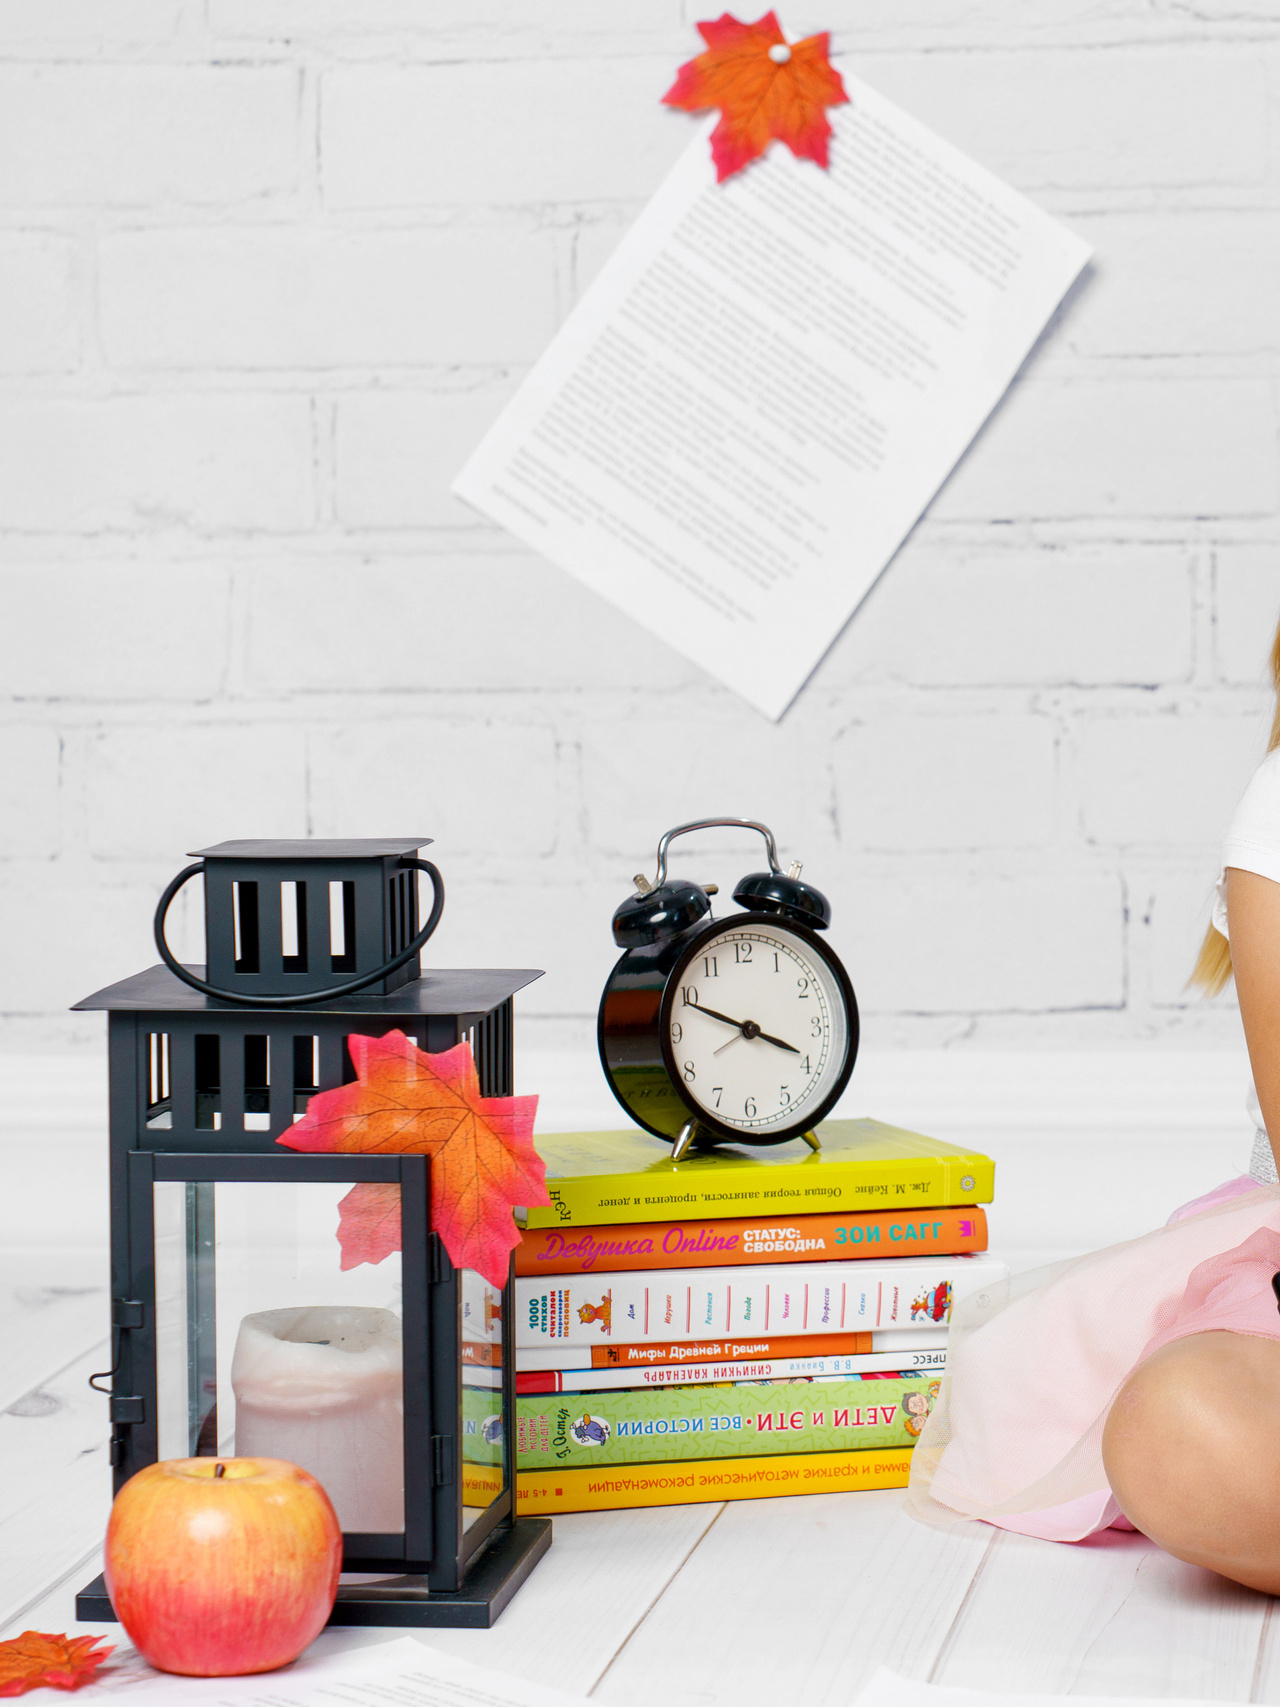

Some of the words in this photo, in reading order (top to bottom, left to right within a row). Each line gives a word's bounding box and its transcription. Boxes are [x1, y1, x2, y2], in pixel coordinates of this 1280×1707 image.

[734, 943, 753, 963] 12
[703, 957, 719, 978] 11
[774, 953, 780, 973] 1
[680, 986, 698, 1006] 10
[798, 978, 809, 999] 2
[671, 1023, 682, 1043] 9
[811, 1017, 822, 1038] 3
[684, 1061, 696, 1081] 8
[800, 1054, 813, 1074] 4
[712, 1087, 723, 1108] 7
[780, 1086, 791, 1106] 5
[744, 1097, 757, 1117] 6
[763, 1188, 801, 1199] теория
[805, 1187, 842, 1198] Общая
[855, 1184, 889, 1195] Кейнс
[892, 1184, 906, 1194] М.
[909, 1181, 931, 1193] Дж.
[598, 1197, 631, 1207] денег
[634, 1197, 641, 1205] и
[644, 1193, 698, 1204] процента
[701, 1191, 760, 1202] занятости,
[743, 1228, 801, 1241] СТАТУС:
[834, 1226, 881, 1245] ЗОИ
[889, 1222, 943, 1241] САГГ
[537, 1233, 654, 1269] Девушка
[662, 1227, 740, 1254] Online
[743, 1238, 826, 1253] СВОБОДНА
[627, 1304, 635, 1320] Дом
[664, 1295, 673, 1324] Игрушки
[821, 1287, 829, 1323] Профессии
[890, 1287, 899, 1321] Животные
[529, 1299, 539, 1329] 1000
[628, 1348, 666, 1361] Мифы
[669, 1344, 721, 1360] Древней
[724, 1343, 769, 1356] Греции
[643, 1368, 708, 1382] КАЛЕНДАРЬ
[714, 1364, 772, 1378] СИНИЧКИН
[790, 1361, 824, 1371] Бианки
[538, 1415, 549, 1435] ДЕТЕЙ
[711, 1415, 742, 1430] ВСЕ
[756, 1411, 804, 1431] ЭТИ
[833, 1405, 897, 1428] ДЕТИ
[518, 1417, 528, 1453] ЛЮБИМЫЕ
[529, 1418, 537, 1450] ИСТОРИИ
[553, 1408, 570, 1446] Остер
[616, 1418, 703, 1437] ИСТОРИИ
[541, 1438, 549, 1452] ДЛЯ
[556, 1446, 571, 1458] Г.
[699, 1469, 800, 1486] методические
[803, 1463, 858, 1479] краткие
[862, 1465, 870, 1474] и
[533, 1488, 547, 1498] 4-5
[588, 1475, 695, 1493] рекомендации
[516, 1489, 528, 1499] ЛЕ
